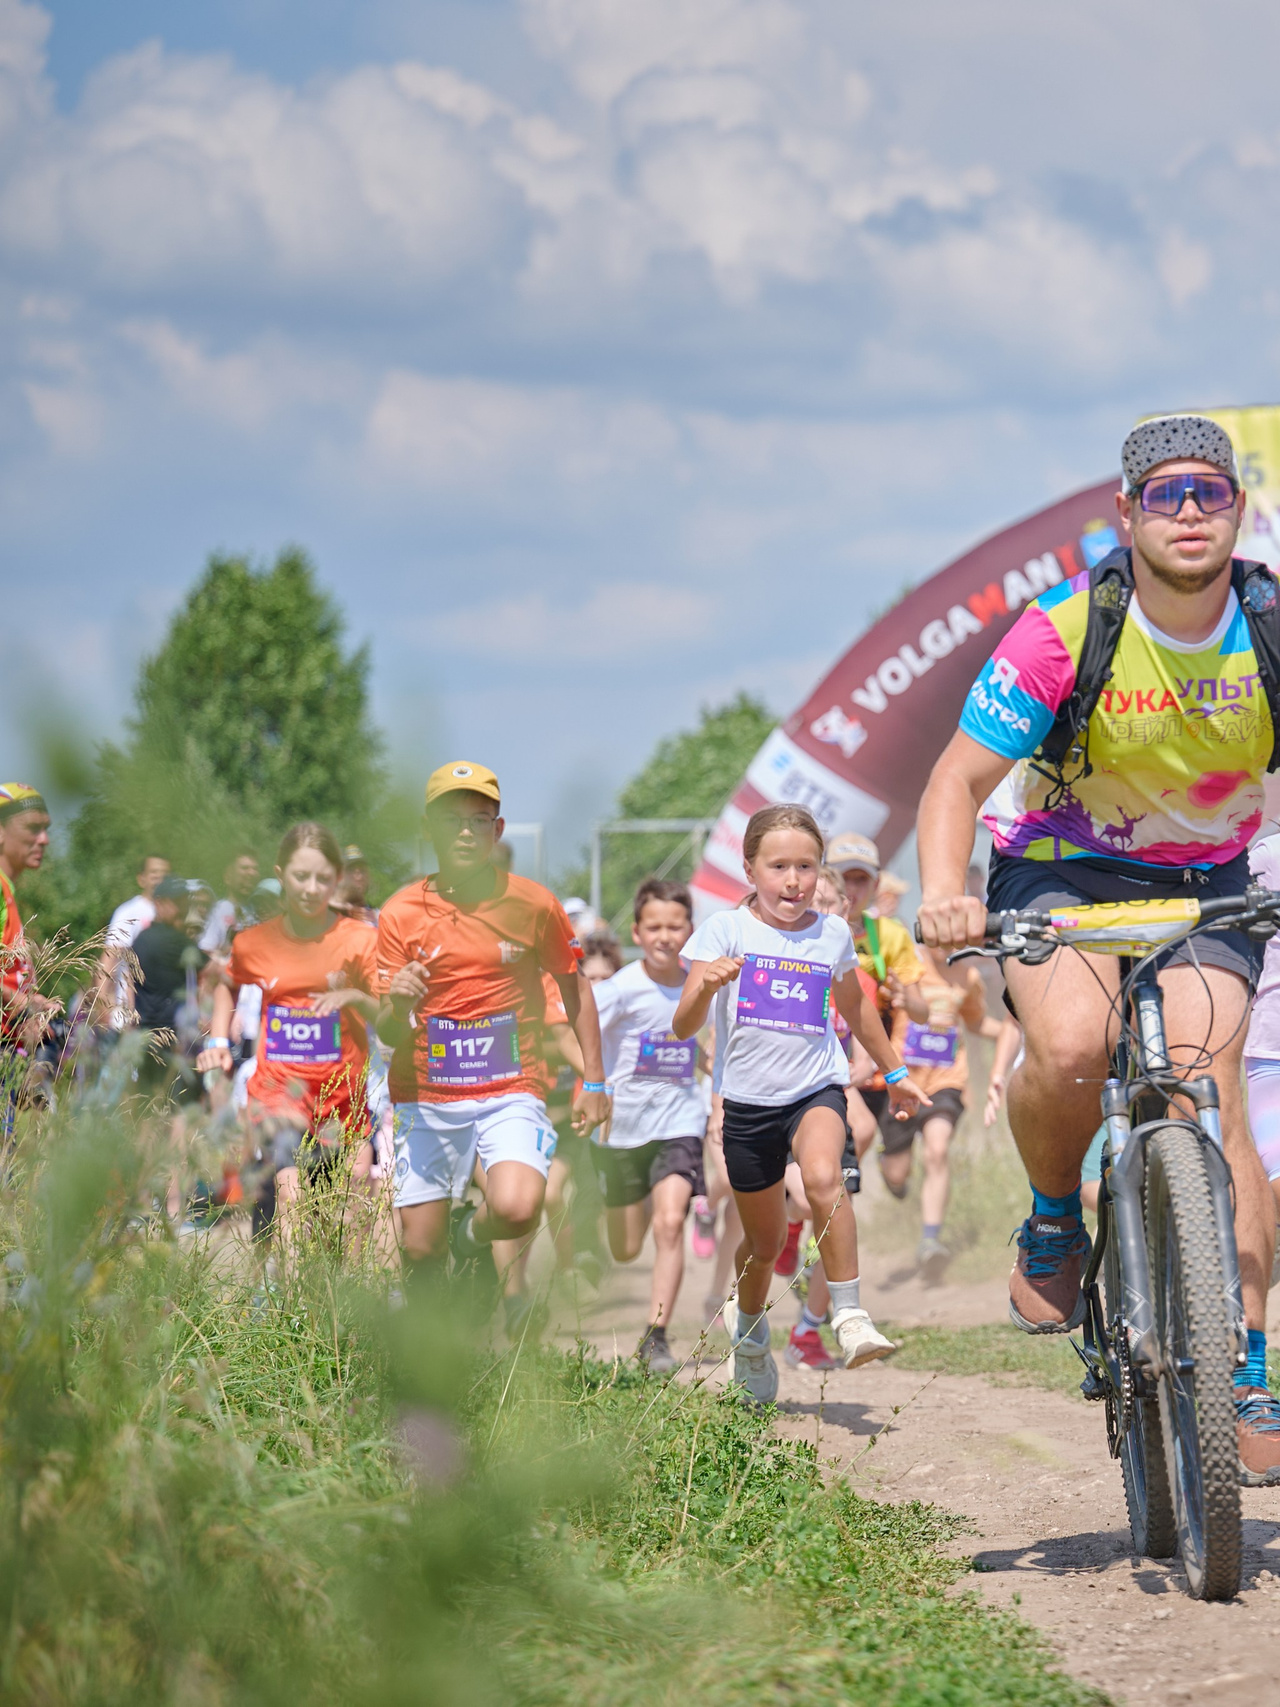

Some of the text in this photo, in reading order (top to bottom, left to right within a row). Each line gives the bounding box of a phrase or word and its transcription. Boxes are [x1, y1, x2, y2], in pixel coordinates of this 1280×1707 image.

[1097, 714, 1183, 745] ТРЕЙЛ
[756, 957, 776, 970] ВТБ
[778, 960, 811, 974] ЛУКА
[770, 979, 809, 1002] 54
[282, 1023, 321, 1041] 101
[438, 1019, 455, 1031] ВТБ
[457, 1019, 491, 1031] ЛУКА
[450, 1036, 495, 1057] 117
[655, 1047, 691, 1064] 123
[459, 1061, 488, 1069] СЕМЕН
[1036, 1223, 1062, 1233] HOKA
